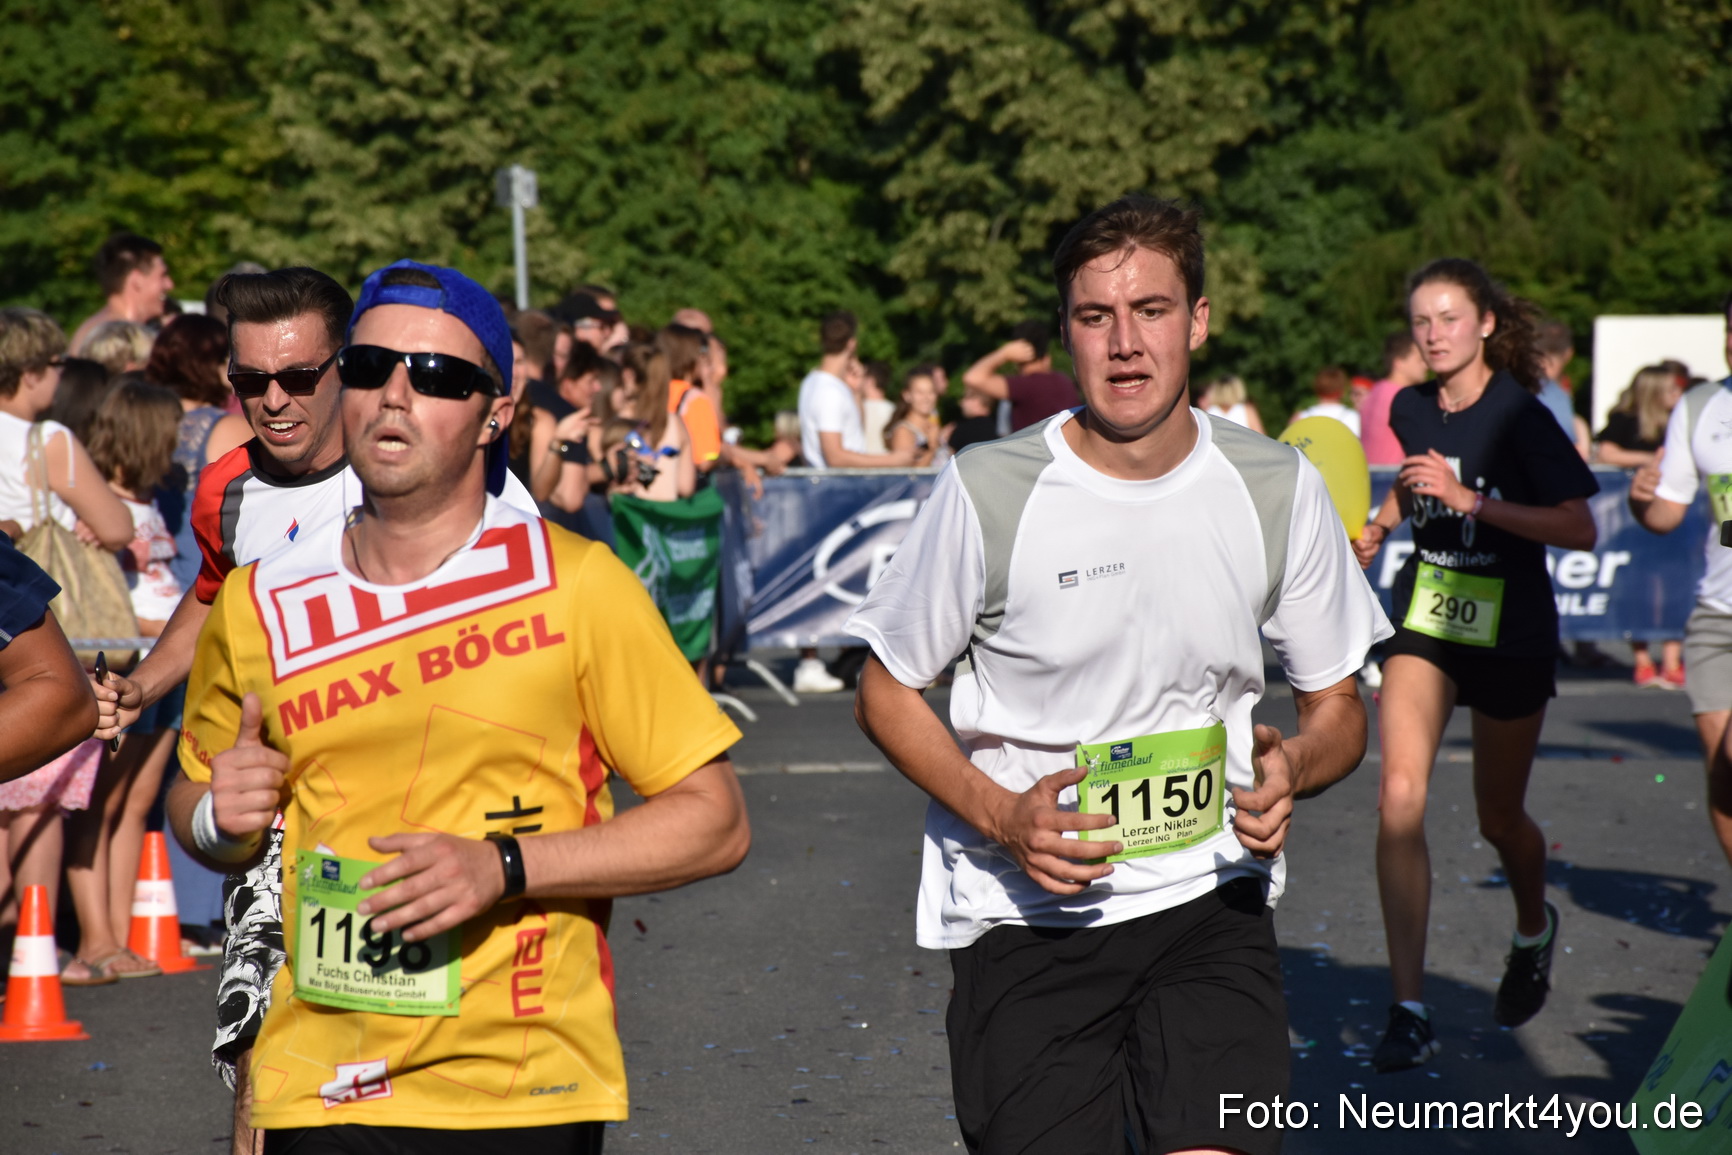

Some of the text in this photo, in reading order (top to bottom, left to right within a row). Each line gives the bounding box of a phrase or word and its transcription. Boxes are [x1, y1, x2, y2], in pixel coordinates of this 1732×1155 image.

[1086, 563, 1125, 577] LERZER
[1430, 593, 1477, 625] 290
[278, 613, 565, 737] MAX BÖGL
[1100, 753, 1154, 772] firmenlauf
[1160, 757, 1190, 771] 2018
[1101, 768, 1213, 825] 1150
[1122, 817, 1198, 838] Lerzer Niklas
[1127, 829, 1193, 847] Lerzer ING Plan
[317, 963, 349, 981] Fuchs
[343, 983, 391, 997] Bauservice
[395, 989, 427, 999] GmbH
